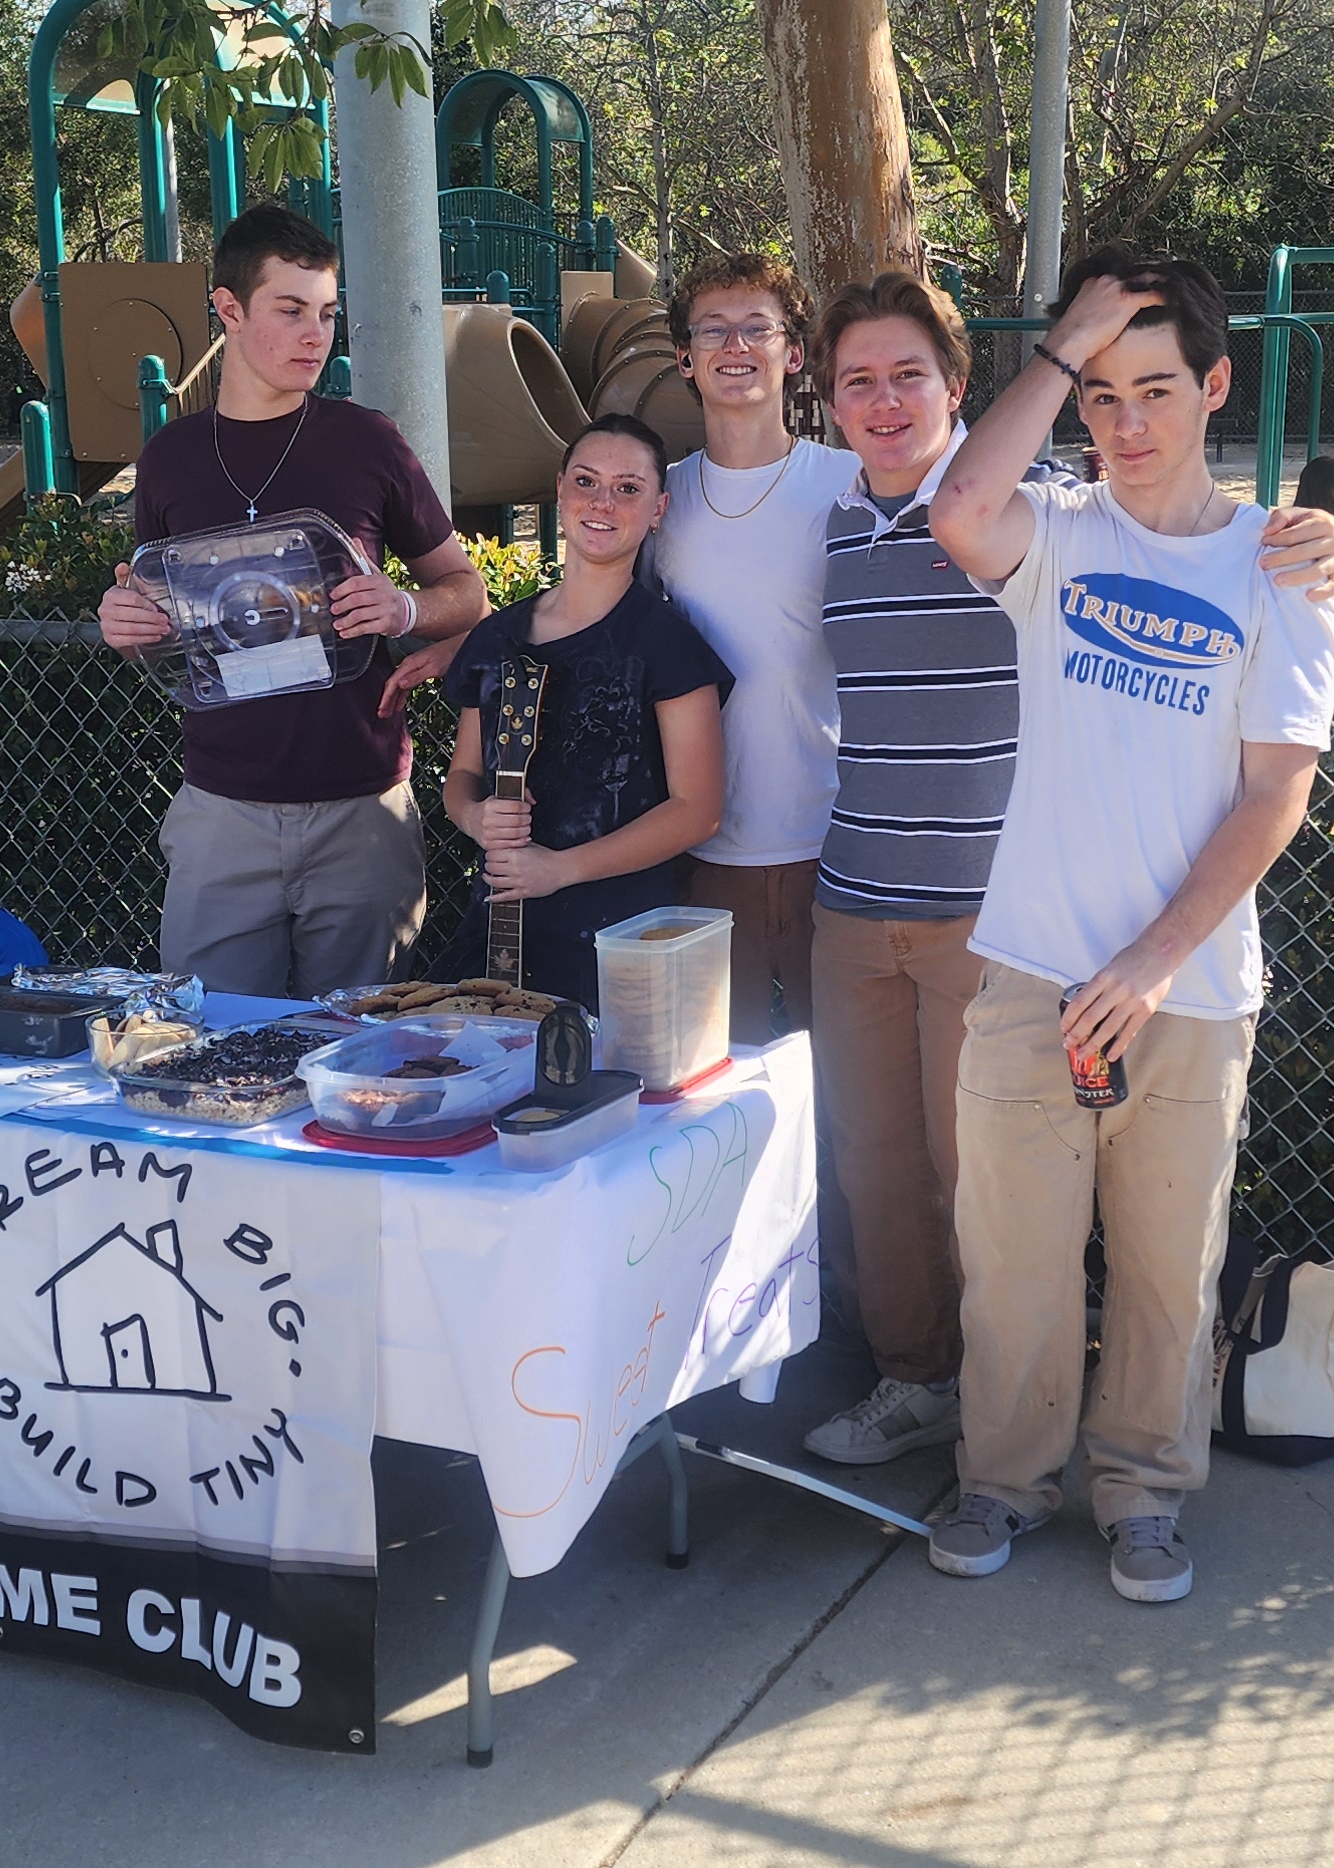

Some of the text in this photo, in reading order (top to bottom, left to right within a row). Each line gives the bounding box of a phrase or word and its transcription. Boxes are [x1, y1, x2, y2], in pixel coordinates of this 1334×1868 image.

[1064, 579, 1240, 662] TRIUMPH
[1064, 649, 1210, 716] MOTORCYCLES
[627, 1101, 748, 1267] SDA
[223, 1223, 305, 1344] BIG
[189, 1407, 304, 1507] TINY
[126, 1588, 303, 1710] CLUB
